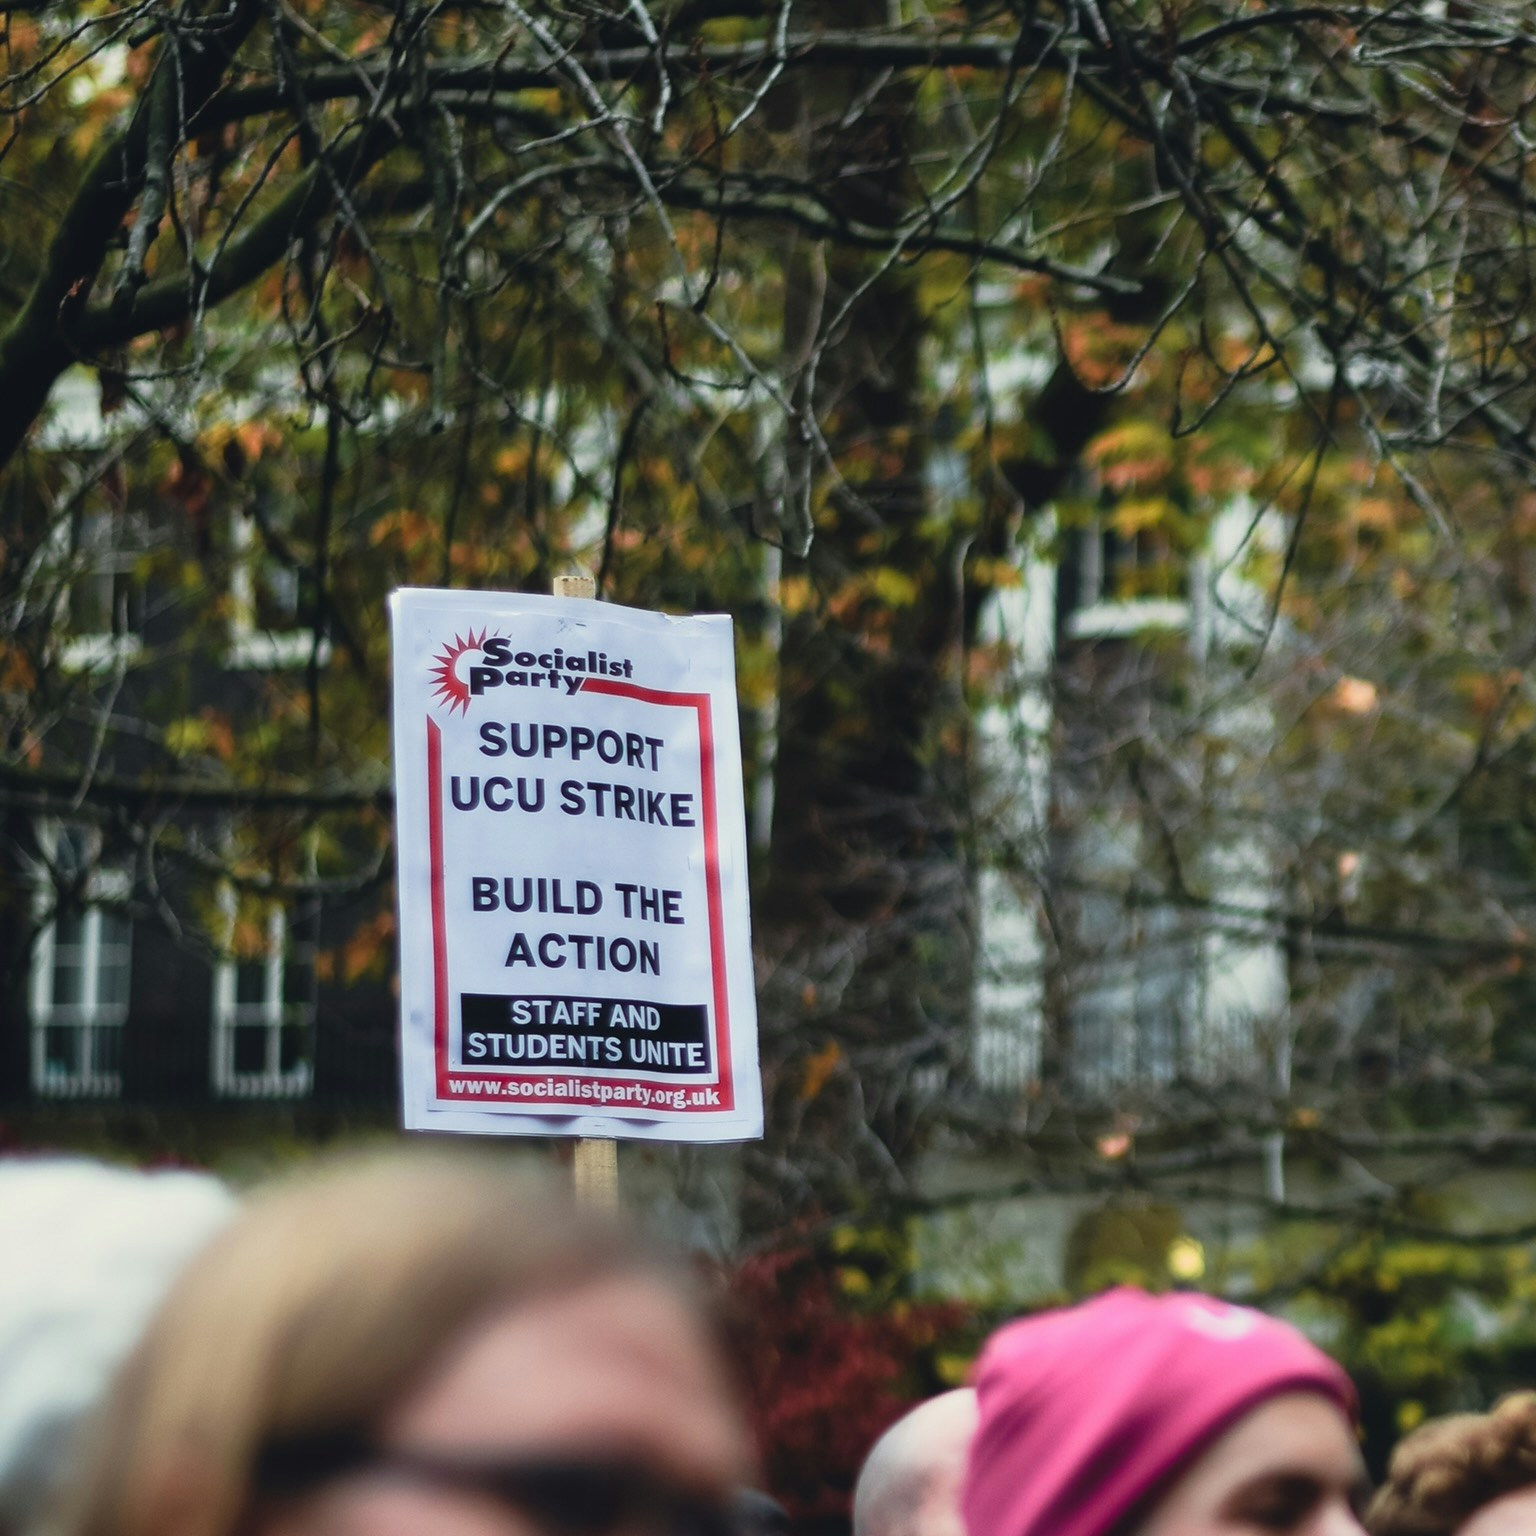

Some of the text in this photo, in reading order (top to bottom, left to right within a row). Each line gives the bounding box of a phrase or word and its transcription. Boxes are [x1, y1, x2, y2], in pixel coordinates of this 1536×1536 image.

[482, 638, 633, 678] Socialist
[479, 722, 663, 771] SUPPORT
[451, 776, 695, 827] UCU STRIKE
[473, 877, 684, 924] BUILD THE
[505, 933, 660, 975] ACTION
[513, 1000, 660, 1030] STAFF AND
[468, 1033, 705, 1066] STUDENTS UNITE
[449, 1078, 720, 1109] www.socialistparty.org.uk
